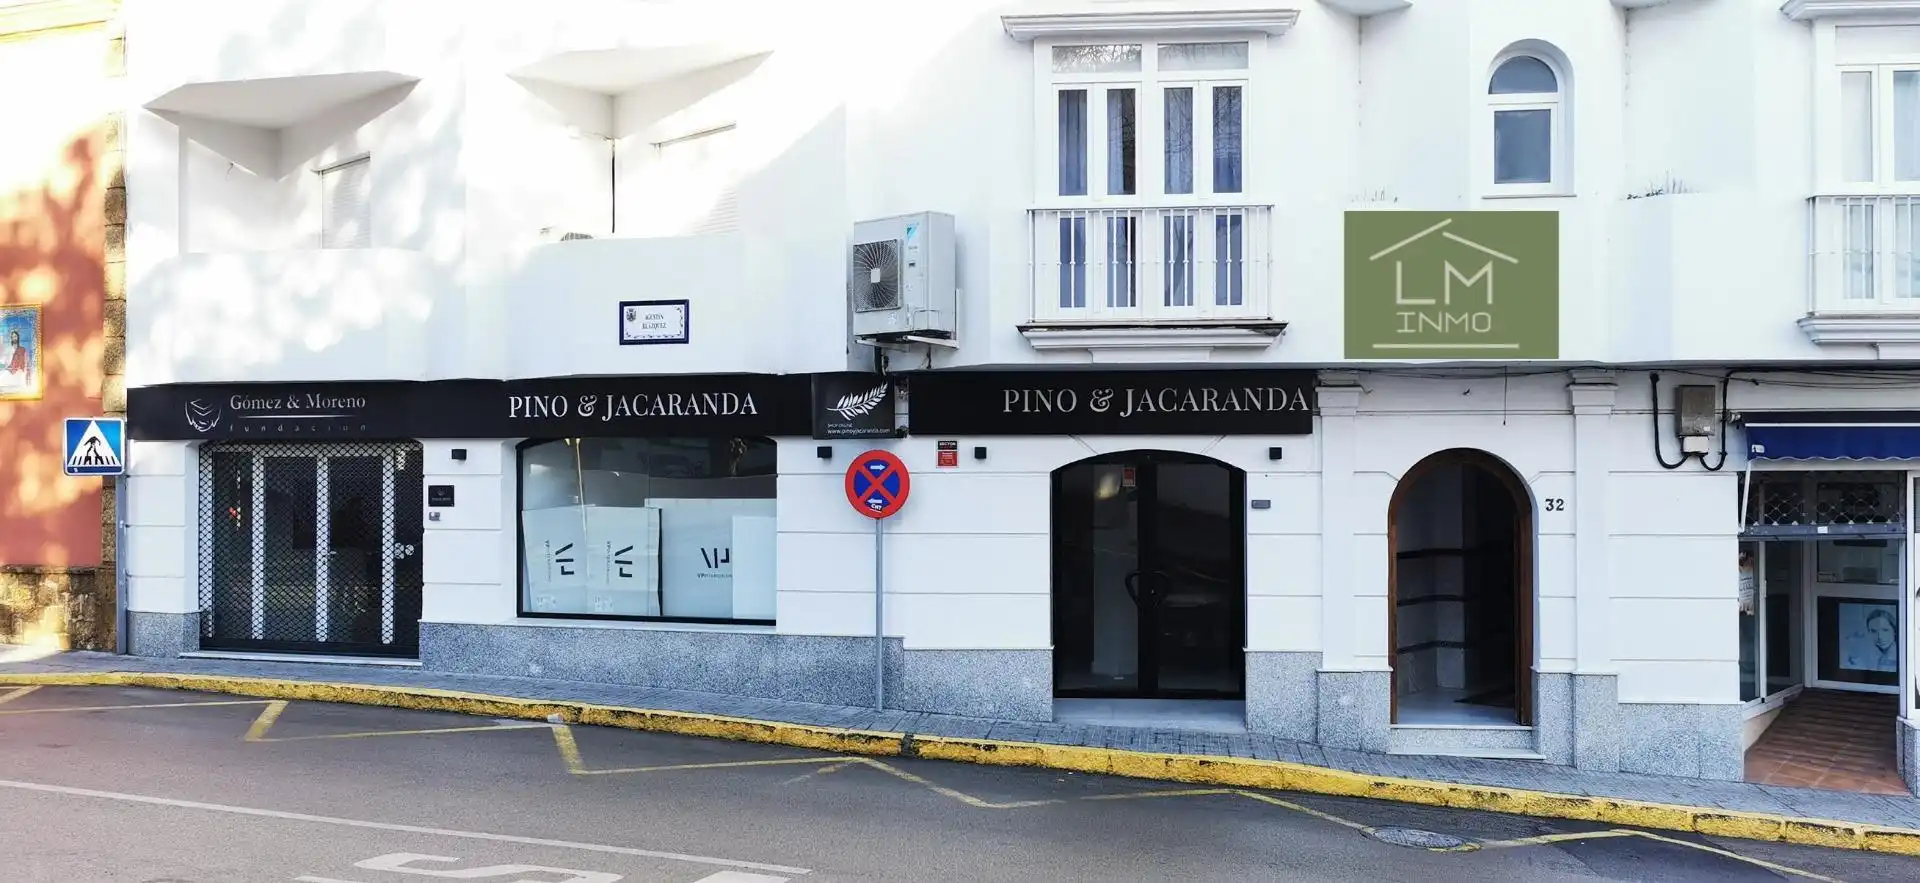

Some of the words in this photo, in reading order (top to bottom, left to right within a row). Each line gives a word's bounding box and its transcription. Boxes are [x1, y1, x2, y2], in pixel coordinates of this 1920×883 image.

[230, 393, 282, 410] Gómez
[286, 393, 300, 409] &
[305, 393, 366, 409] Moreno
[508, 395, 568, 418] PINO
[577, 394, 598, 417] &
[602, 392, 758, 422] JACARANDA
[1003, 389, 1077, 413] PINO
[1090, 388, 1114, 412] &
[1119, 387, 1309, 417] JACARANDA
[1545, 498, 1564, 511] 32
